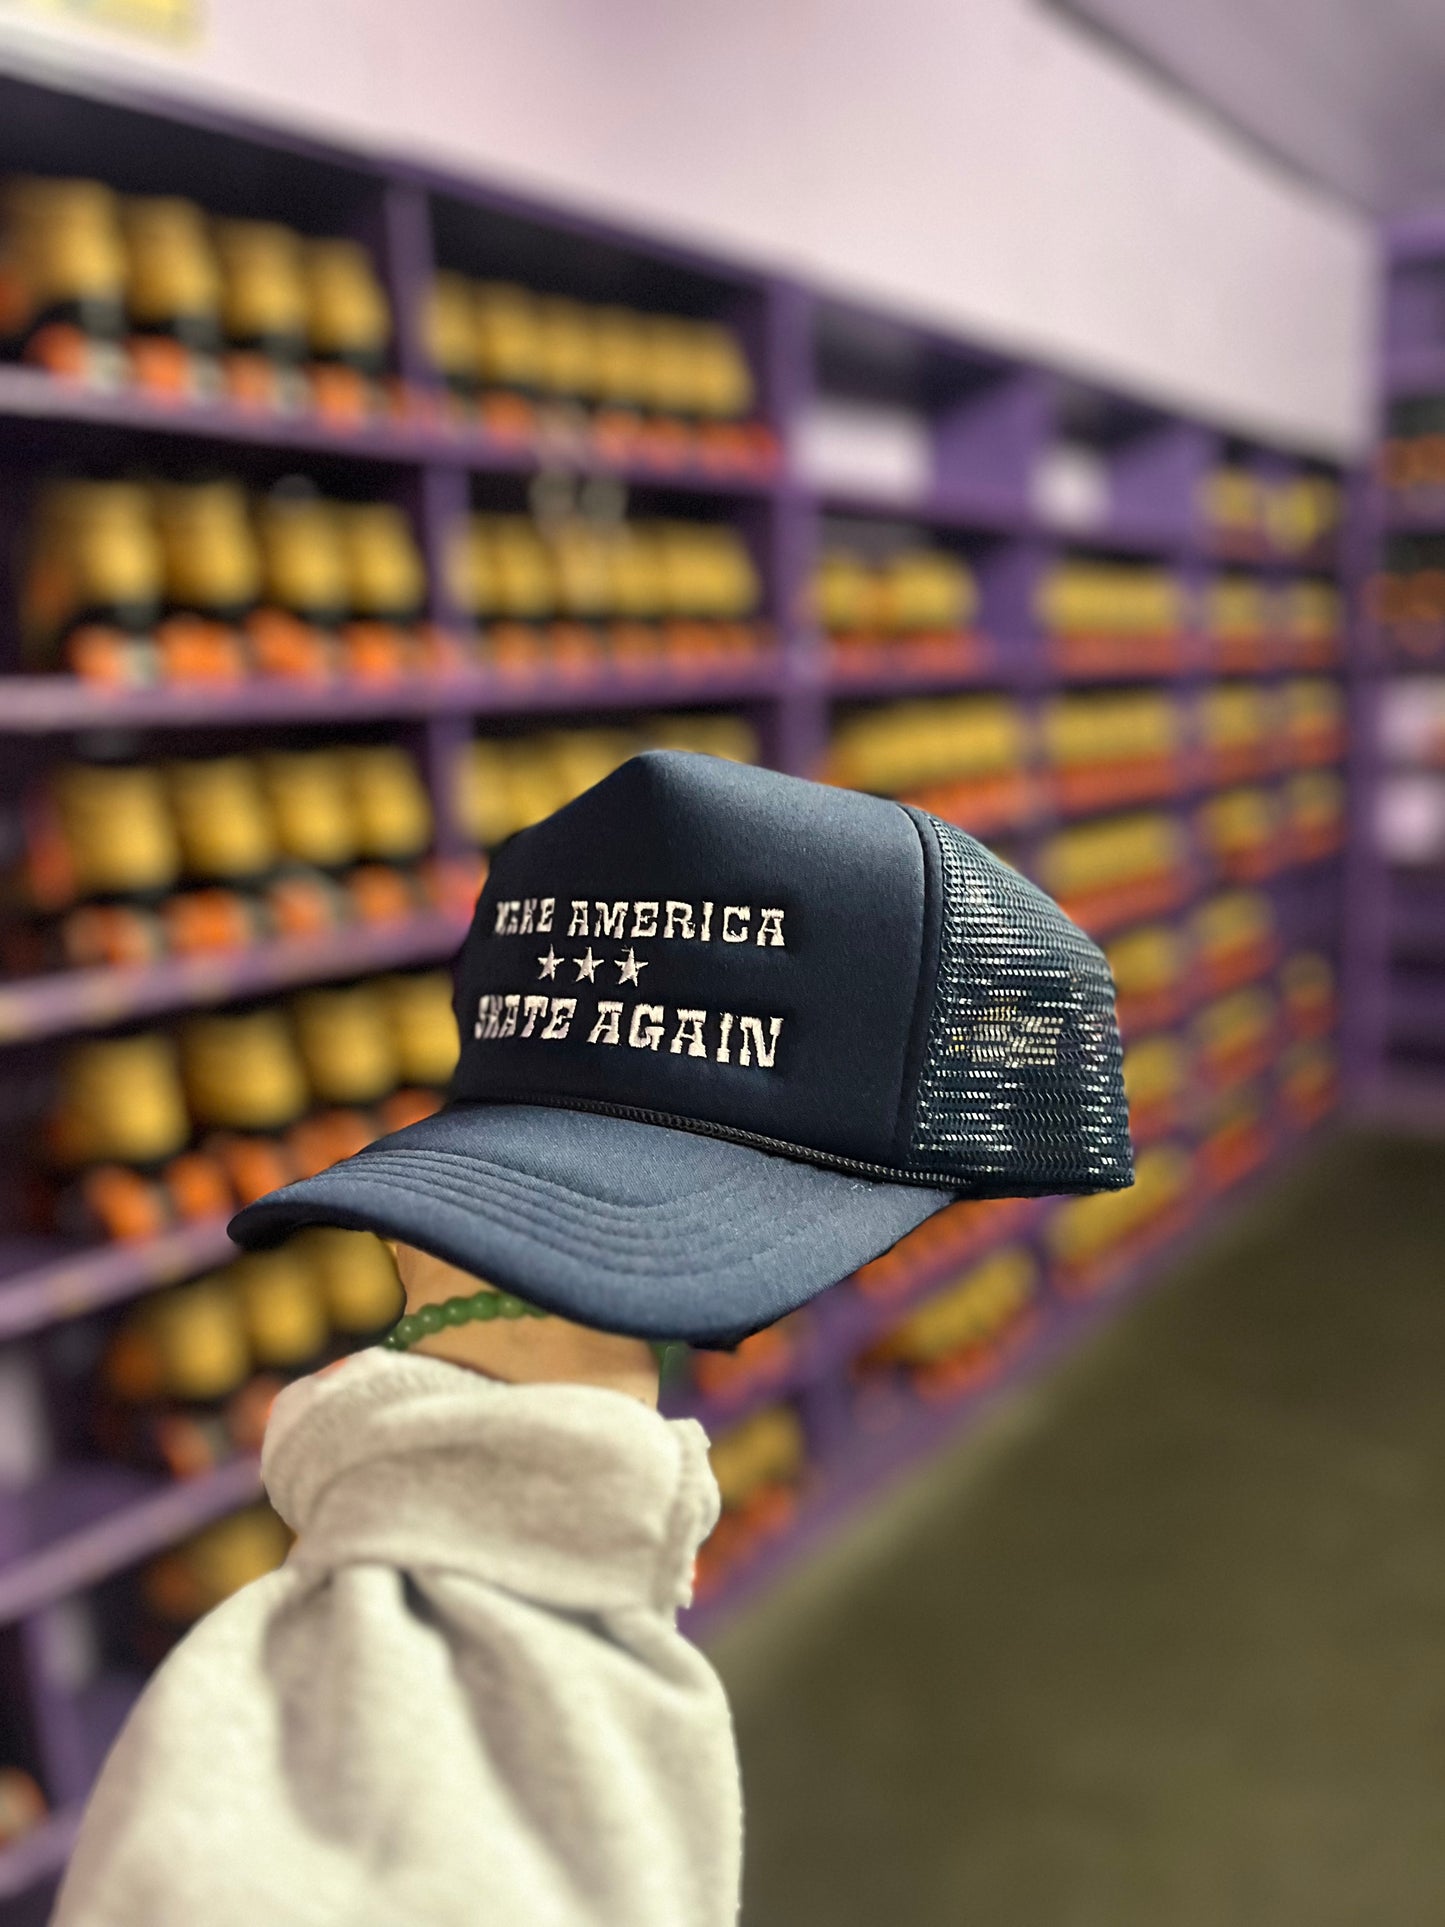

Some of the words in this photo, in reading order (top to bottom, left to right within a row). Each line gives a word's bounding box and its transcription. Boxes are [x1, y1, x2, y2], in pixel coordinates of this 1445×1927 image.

[567, 901, 785, 946] AMERICA
[474, 995, 577, 1039] SKATE
[586, 1001, 784, 1067] AGAIN
